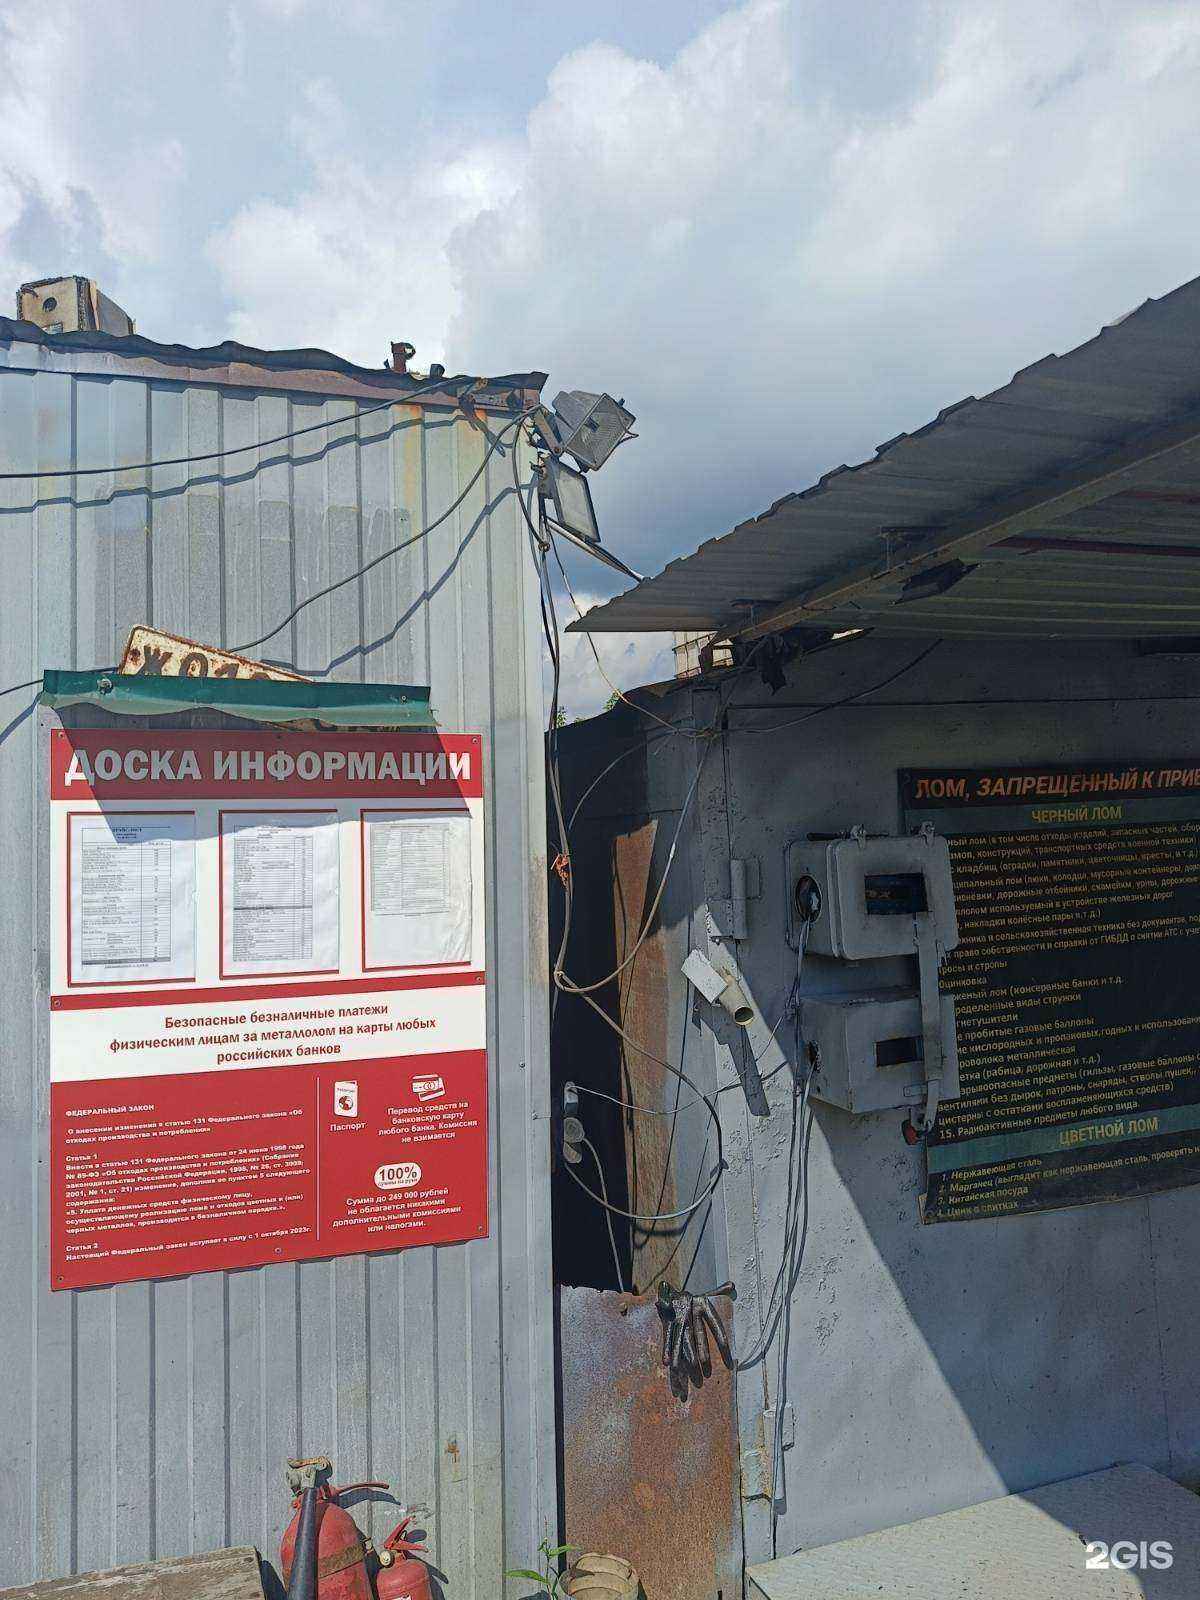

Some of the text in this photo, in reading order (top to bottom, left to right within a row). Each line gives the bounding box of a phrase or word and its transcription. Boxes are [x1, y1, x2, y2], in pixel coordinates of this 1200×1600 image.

[64, 749, 470, 786] ДОСКА ИНФОРМАЦИИ
[915, 778, 971, 801] ЛОМ,
[976, 768, 1138, 797] ЗАПРЕЩЕННЫЙ
[1141, 771, 1153, 788] К
[1032, 804, 1122, 823] ЧЕРНЫЙ ЛОМ
[938, 977, 987, 989] Оцинковка
[165, 1005, 389, 1029] Безопасные безналичные платежи
[110, 1019, 436, 1053] физическим лицам за металлолом на карты любых
[965, 1018, 1094, 1041] пробитые газовые баллоны
[217, 1044, 341, 1065] российских банков
[969, 1039, 1032, 1053] кислородных
[1007, 1045, 1076, 1063] металлическая
[1026, 1059, 1072, 1074] дорожная
[1033, 1070, 1077, 1084] предметы
[1119, 1060, 1154, 1071] газовые
[1157, 1054, 1194, 1066] баллоны
[938, 1098, 989, 1112] вентилями
[991, 1094, 1008, 1104] без
[1131, 1072, 1163, 1083] стволы
[66, 1104, 155, 1117] ФЕДЕРАЛЬНЫЙ ЗАКОН
[387, 1106, 424, 1117] Перевод
[425, 1102, 458, 1113] средств
[938, 1081, 1174, 1126] цистерны с остатками воспламеняющихся средств)
[208, 1113, 260, 1123] Федерального
[330, 1122, 366, 1132] Паспорт
[392, 1111, 464, 1125] банковскую карту
[939, 1100, 1140, 1139] 15. Радиоактивные предметы любого вида.
[378, 1120, 478, 1136] любого банка. Комиссия
[401, 1131, 456, 1144] не взимается
[1059, 1117, 1159, 1146] ЦВЕТНОЙ ЛОМ
[145, 1153, 199, 1164] Федерального
[379, 1166, 418, 1181] 100%
[949, 1179, 993, 1193] Марганец
[1152, 1146, 1193, 1161] проверять
[951, 1161, 1016, 1181] Нержавеющая
[346, 1187, 449, 1206] Сумма до 249 000 рублей
[948, 1186, 1029, 1205] Китайская посуда
[359, 1203, 406, 1214] облагается
[407, 1198, 446, 1208] никакими
[332, 1206, 462, 1228] дополнительными комиссиями
[367, 1220, 427, 1234] или налогами.
[66, 1244, 92, 1252] Статья
[66, 1251, 110, 1261] Настоящий
[111, 1244, 164, 1255] Федеральный
[165, 1242, 188, 1250] закон
